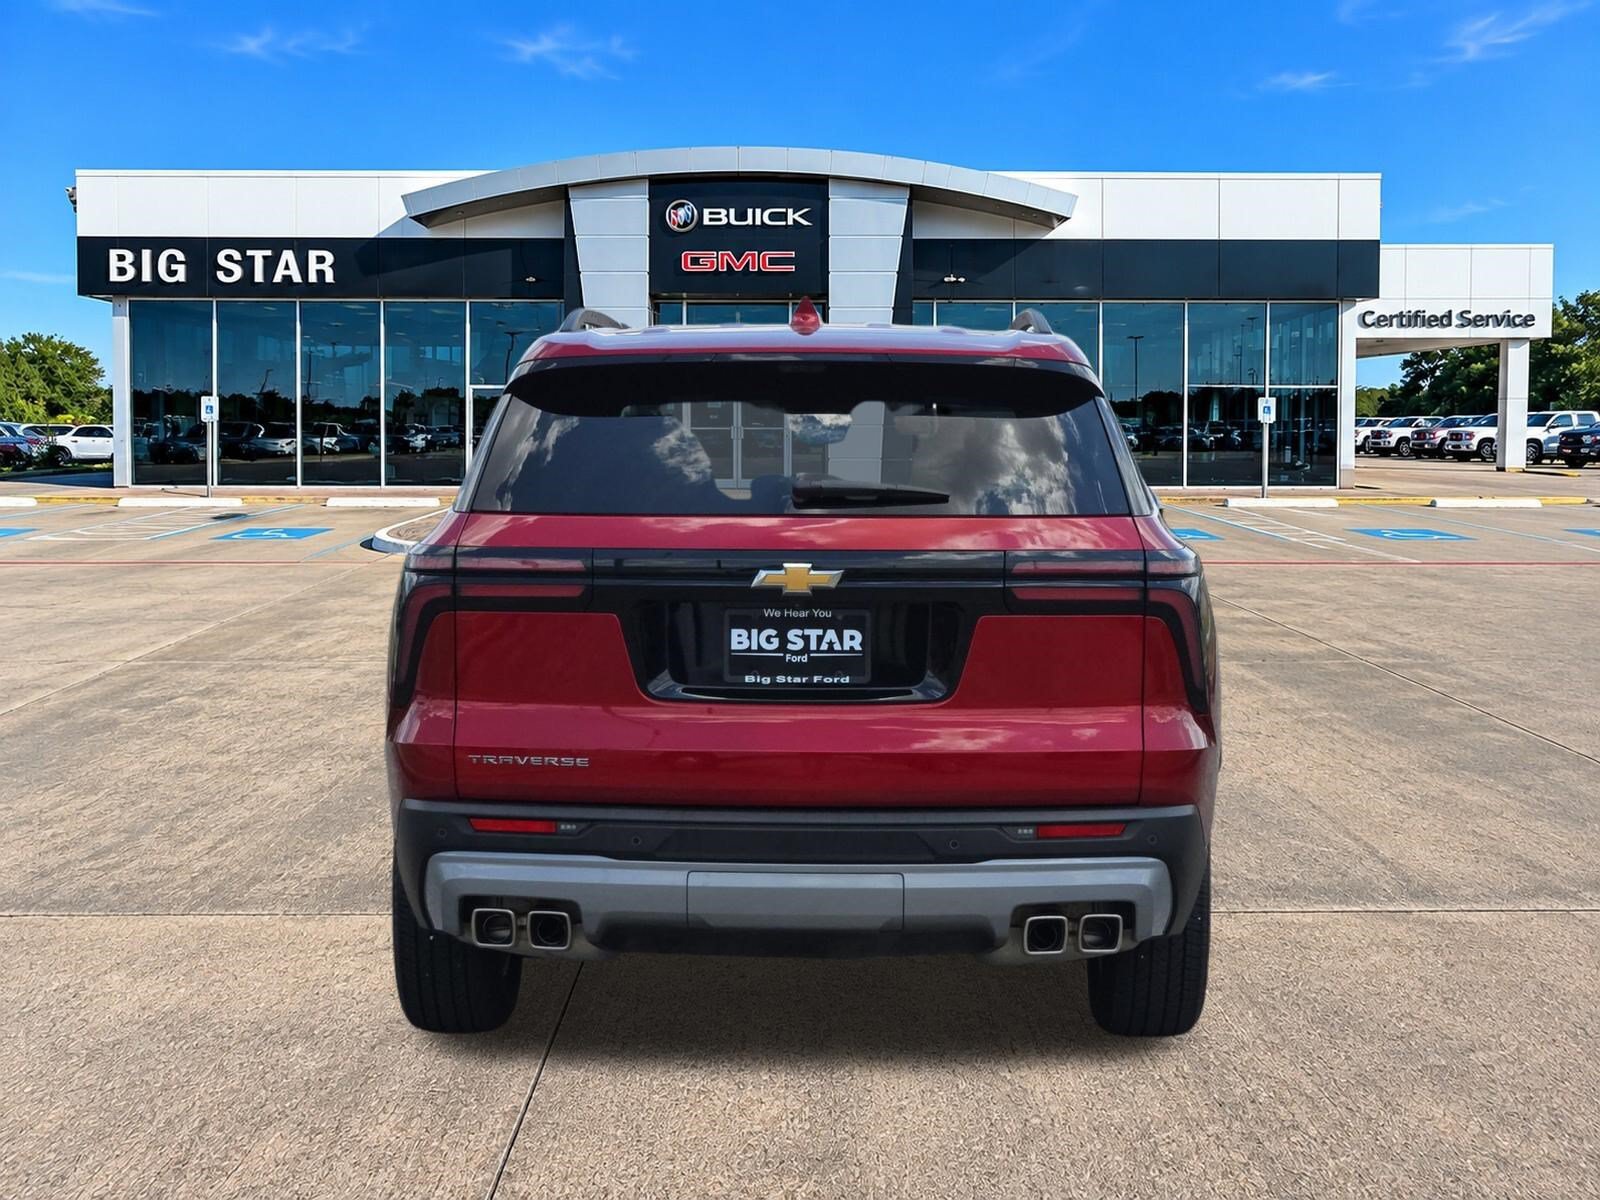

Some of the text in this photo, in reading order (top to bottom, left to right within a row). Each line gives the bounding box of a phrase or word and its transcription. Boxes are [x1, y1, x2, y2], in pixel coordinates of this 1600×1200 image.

[703, 207, 812, 226] BUICK
[108, 248, 336, 284] BIG STAR
[681, 251, 795, 272] GMC
[1359, 309, 1536, 329] Certified Service
[764, 608, 832, 618] We Hear You
[730, 628, 863, 651] BIG STAR
[785, 653, 808, 663] Ford
[744, 675, 850, 684] Big Star Ford
[467, 754, 589, 767] TRAVERSE
